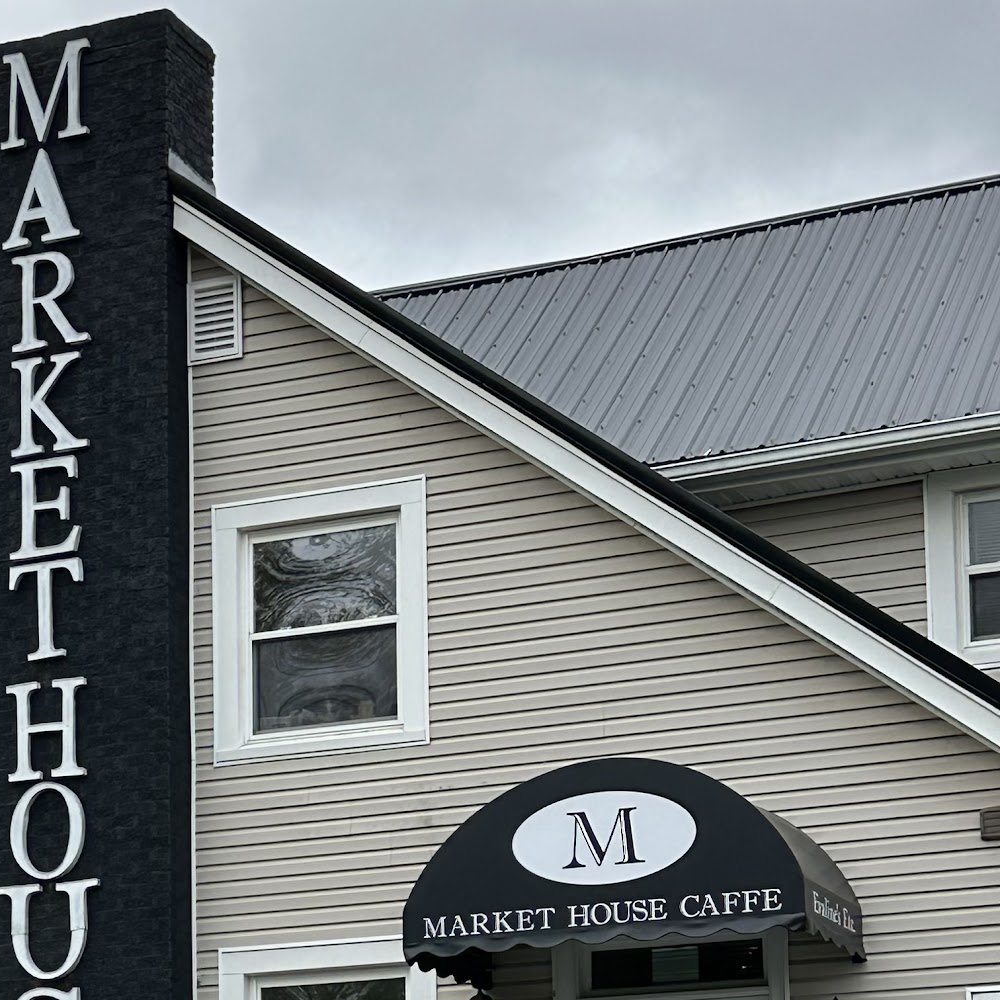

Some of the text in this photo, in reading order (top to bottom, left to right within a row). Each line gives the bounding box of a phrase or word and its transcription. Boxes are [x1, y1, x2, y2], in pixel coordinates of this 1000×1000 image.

[0, 37, 92, 662] MARKET
[562, 806, 646, 869] M
[422, 888, 783, 939] MARKET HOUSE CAFFE
